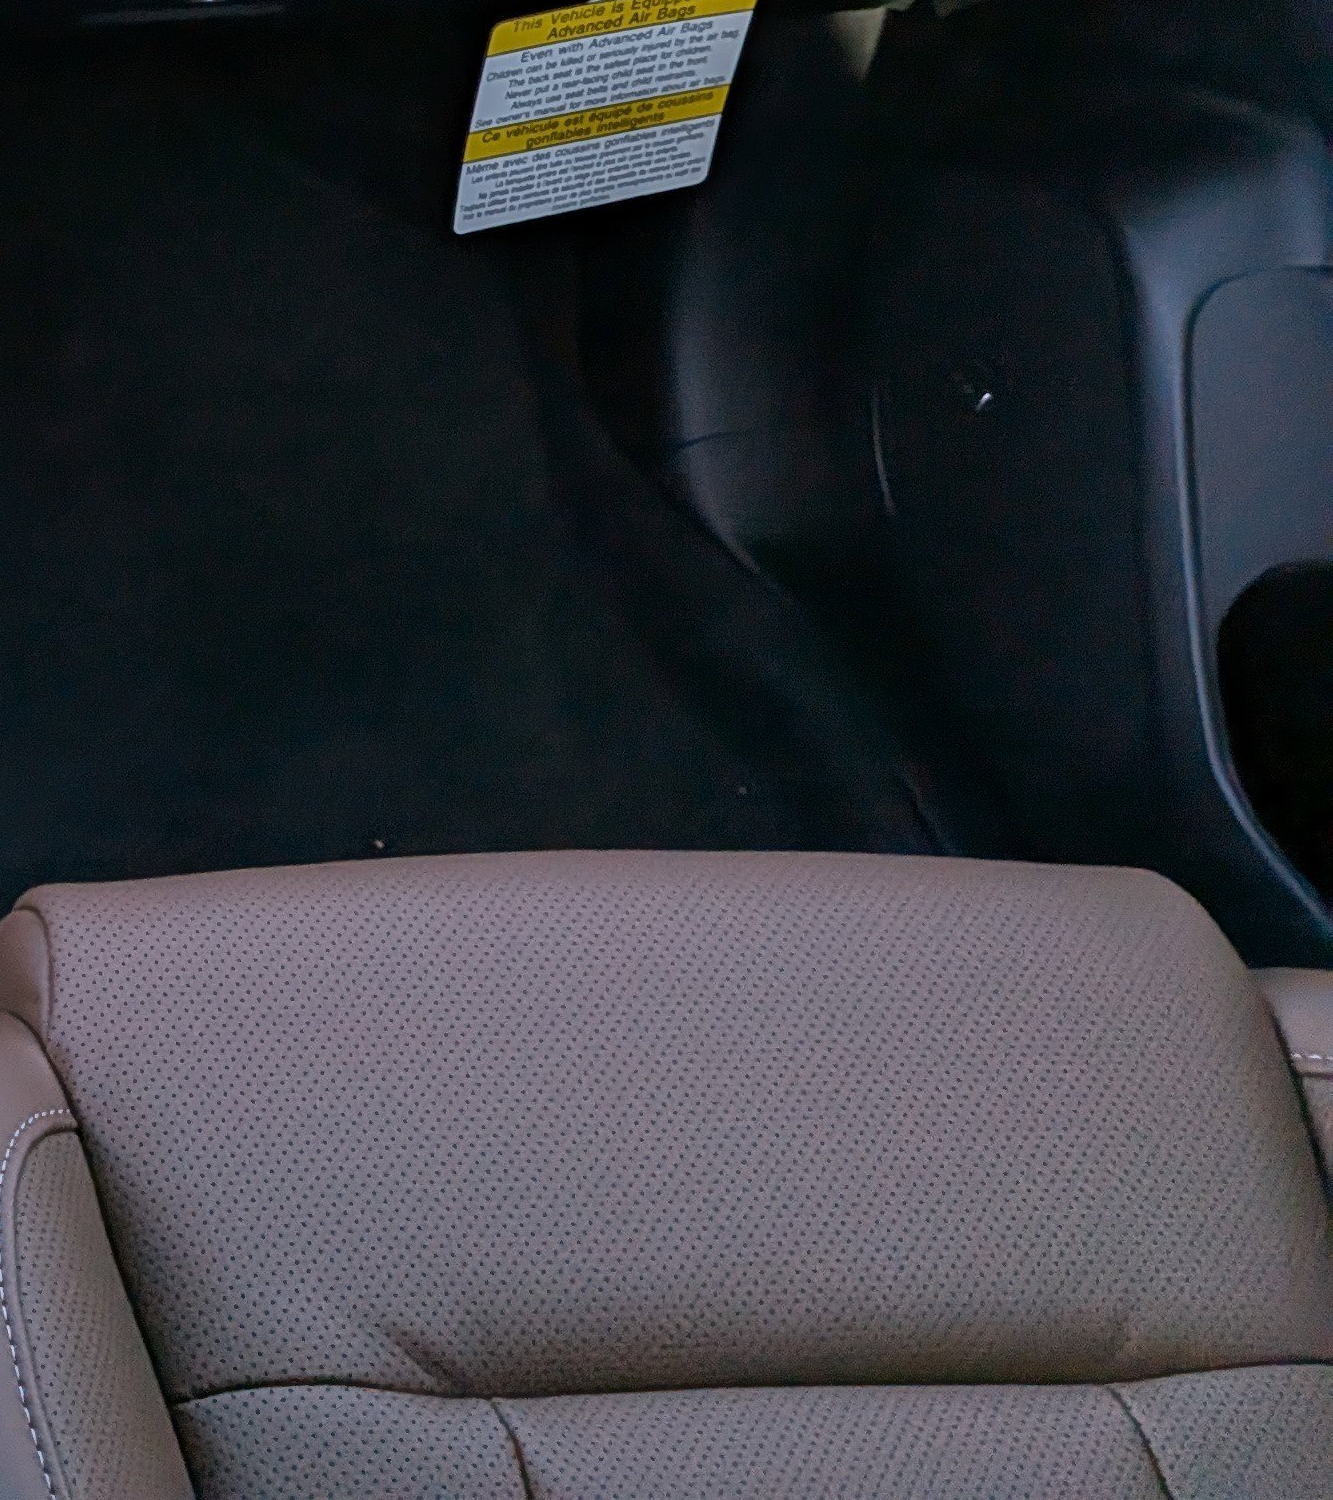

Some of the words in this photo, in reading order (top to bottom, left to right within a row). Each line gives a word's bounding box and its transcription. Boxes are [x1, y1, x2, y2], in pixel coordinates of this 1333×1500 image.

[513, 19, 543, 33] This
[550, 5, 606, 25] Vehicle
[611, 1, 624, 13] is
[546, 15, 623, 40] Advanced
[629, 11, 651, 25] Air
[656, 5, 697, 21] Bags
[520, 49, 553, 63] Even
[558, 42, 584, 54] with
[588, 29, 653, 50] Advanced
[656, 26, 676, 37] Air
[680, 20, 714, 34] Bags
